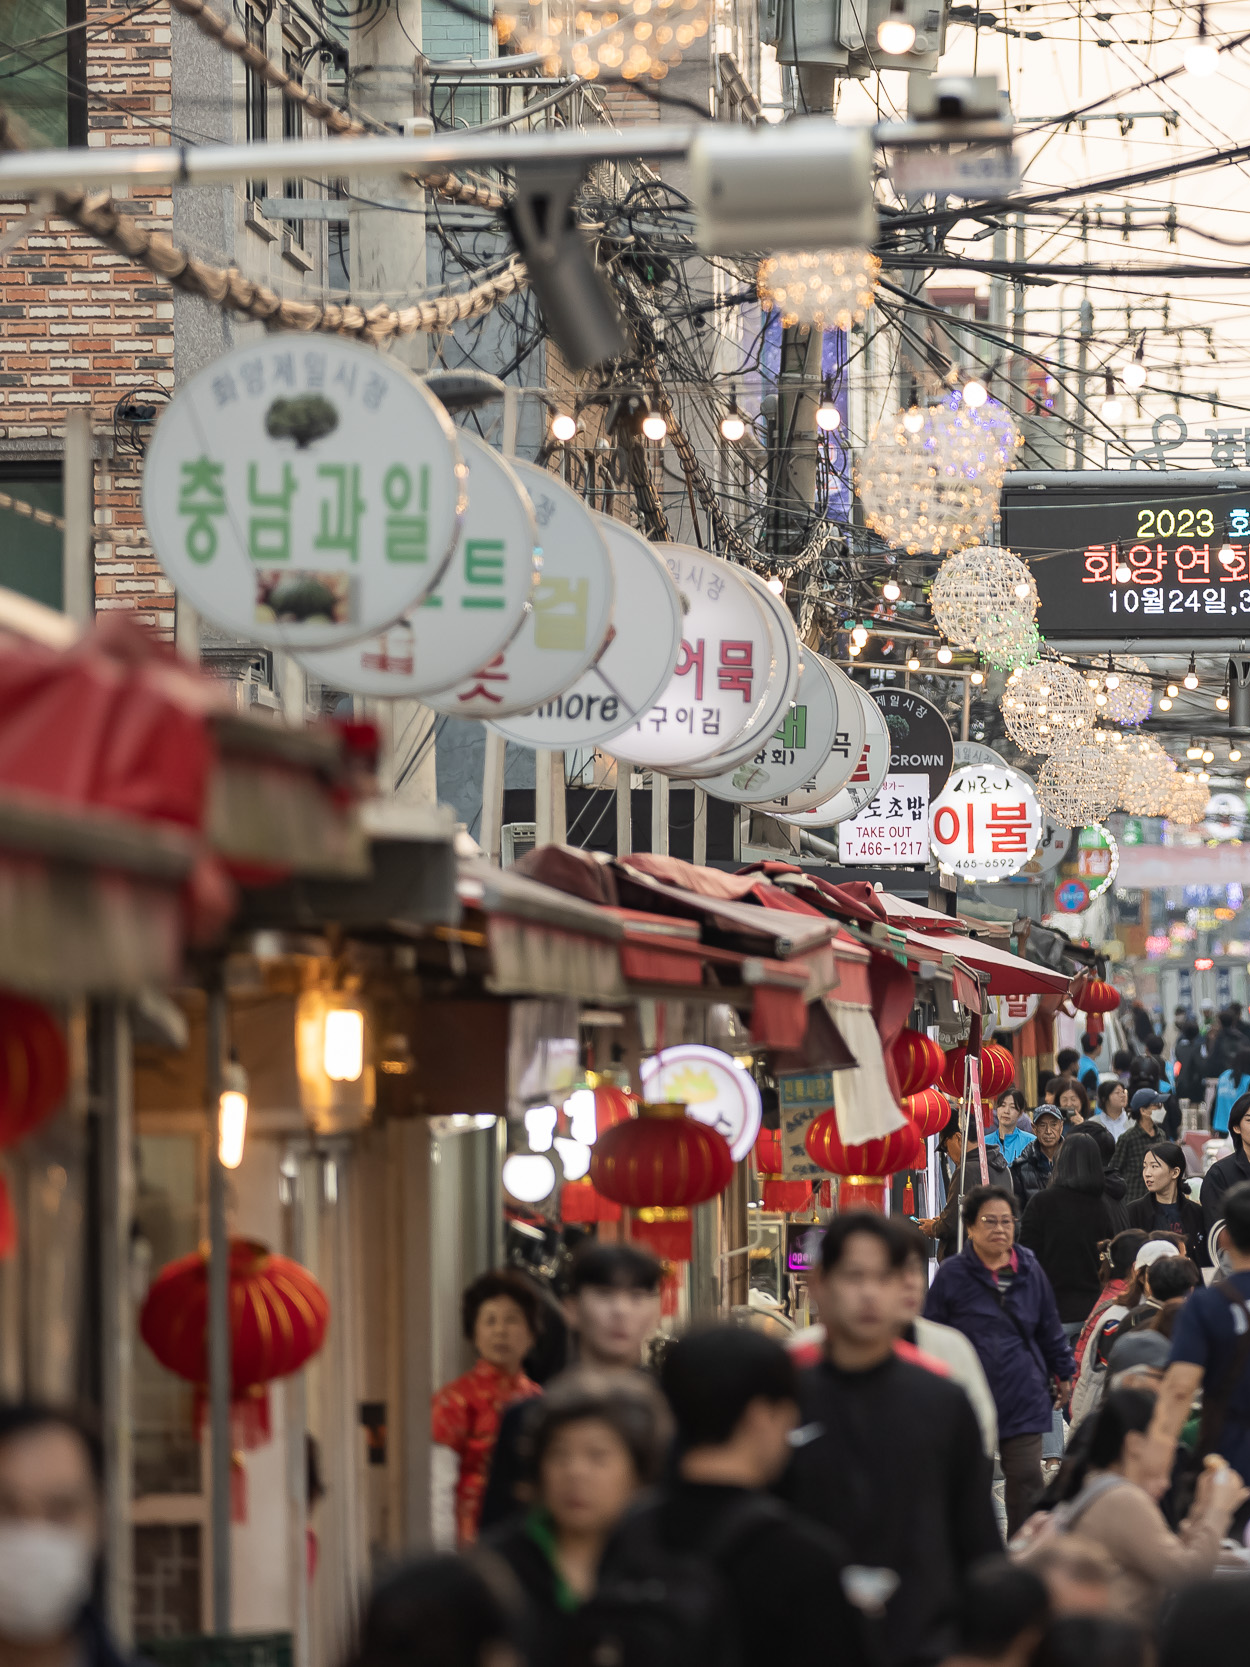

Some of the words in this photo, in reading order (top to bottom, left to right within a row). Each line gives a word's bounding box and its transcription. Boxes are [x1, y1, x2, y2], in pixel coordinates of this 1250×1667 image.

[178, 454, 432, 566] 충남과일
[1136, 508, 1216, 539] 2023
[889, 754, 944, 767] CROWN
[953, 775, 1013, 796] 새로나
[852, 795, 925, 822] 도초밥
[857, 826, 885, 838] TAKE
[889, 826, 912, 838] OUT
[933, 802, 1033, 854] 이불
[846, 841, 923, 857] T.466-1217
[955, 858, 1015, 869] 465-6592
